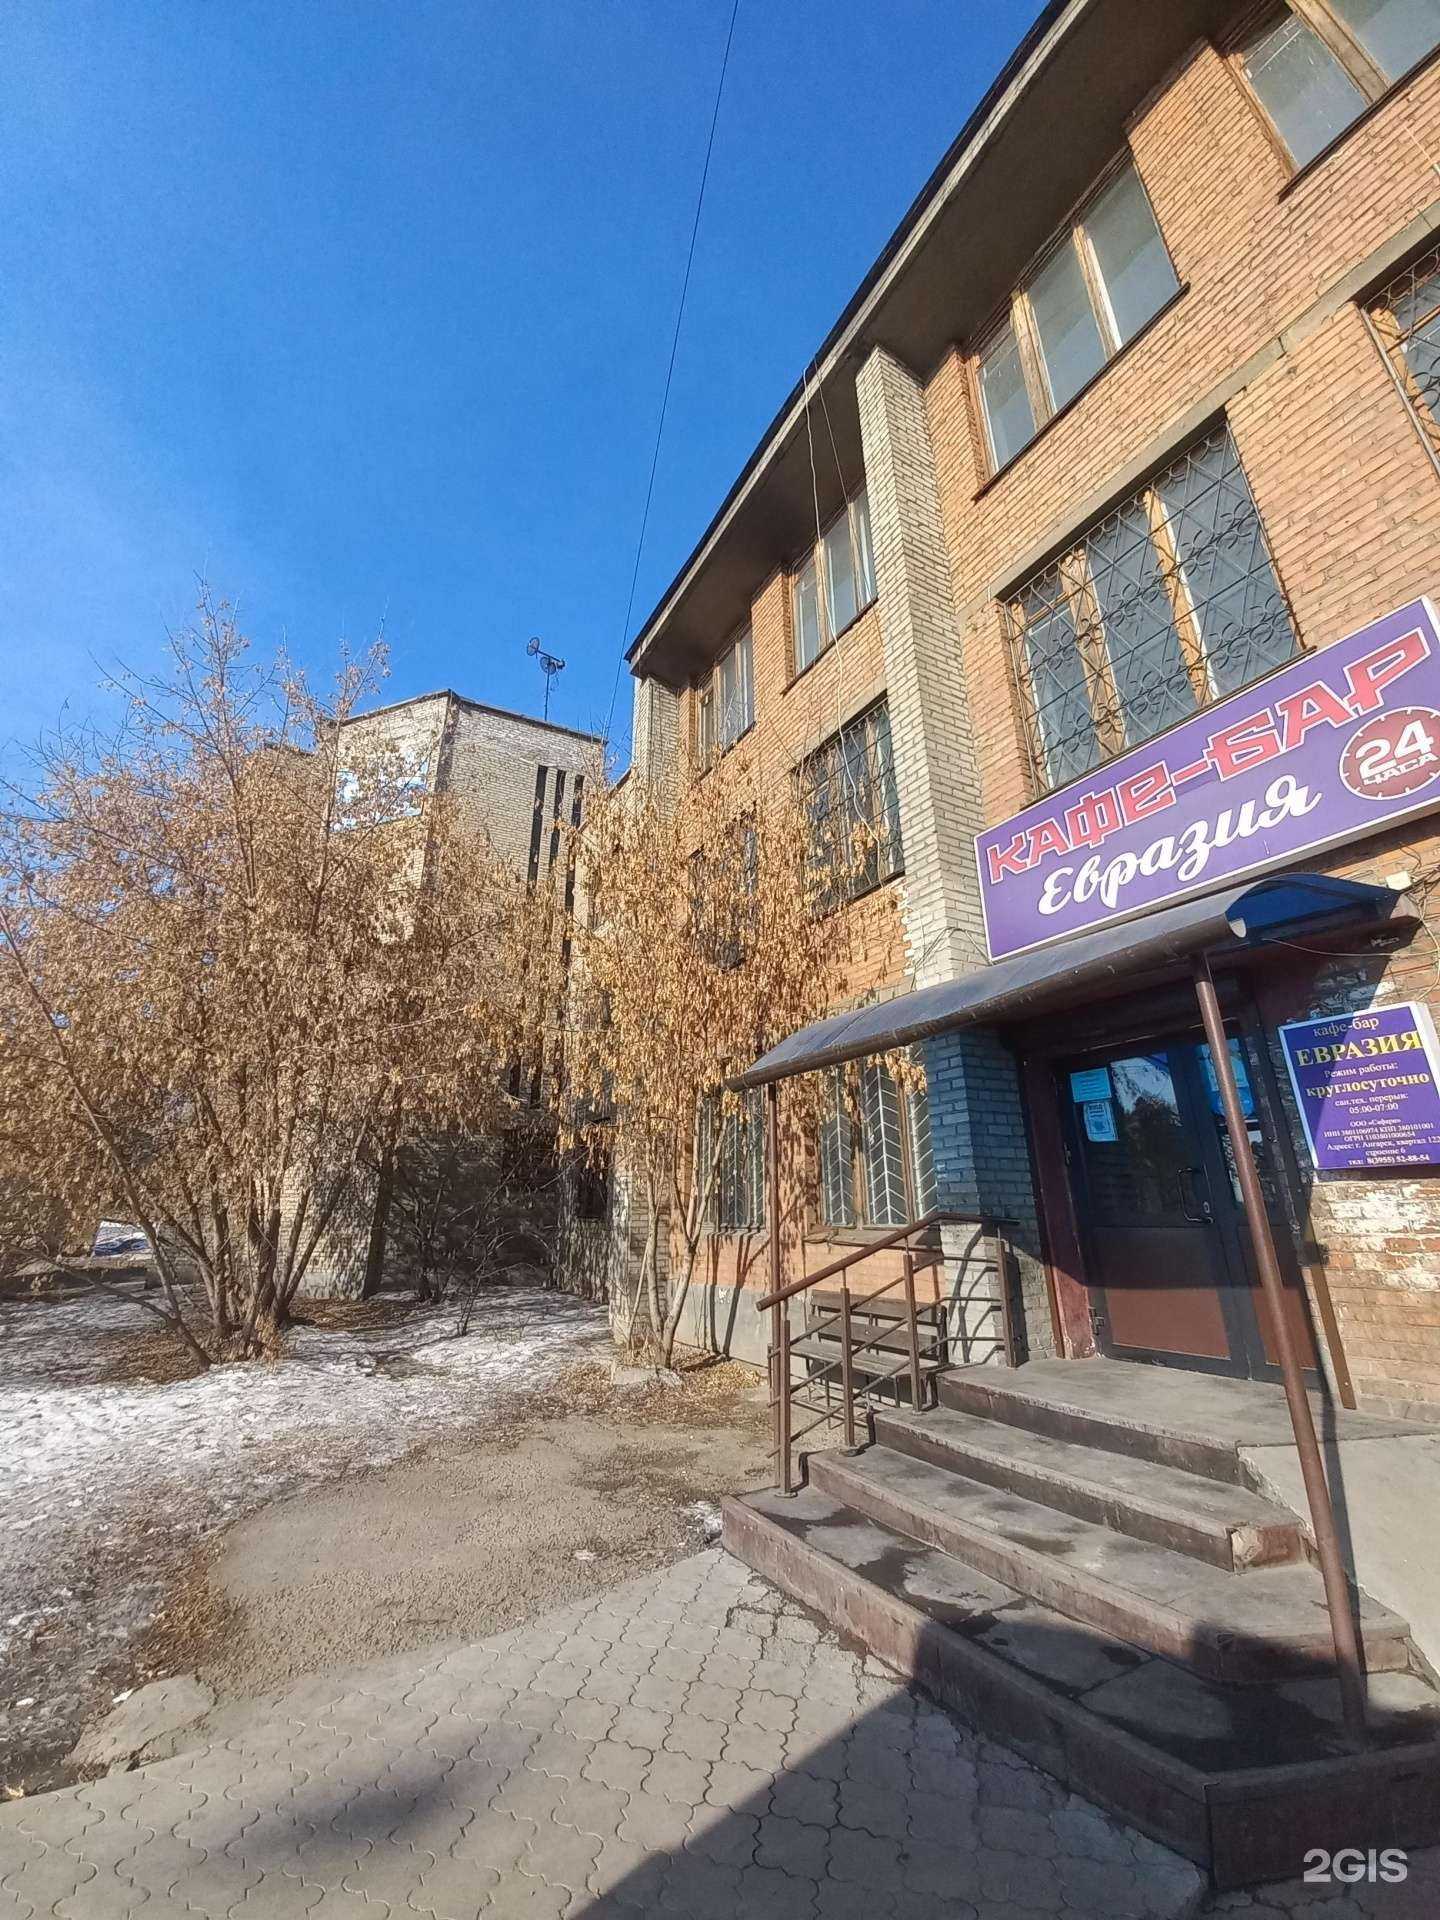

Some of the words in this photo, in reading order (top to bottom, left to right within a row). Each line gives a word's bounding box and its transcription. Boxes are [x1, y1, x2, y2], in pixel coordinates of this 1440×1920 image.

[988, 627, 1431, 884] КАФЕ-БАР
[1355, 719, 1435, 779] 24
[1363, 752, 1439, 786] ЧАСА
[1037, 774, 1323, 916] Евразия
[1313, 1017, 1379, 1037] кафе-бар
[1295, 1030, 1424, 1067] ЕВРАЗИЯ
[1306, 1072, 1430, 1099] круглосуточно
[1324, 1067, 1357, 1079] Режим
[1359, 1062, 1398, 1075] работы:
[1349, 1103, 1399, 1114] 05:00-07:00
